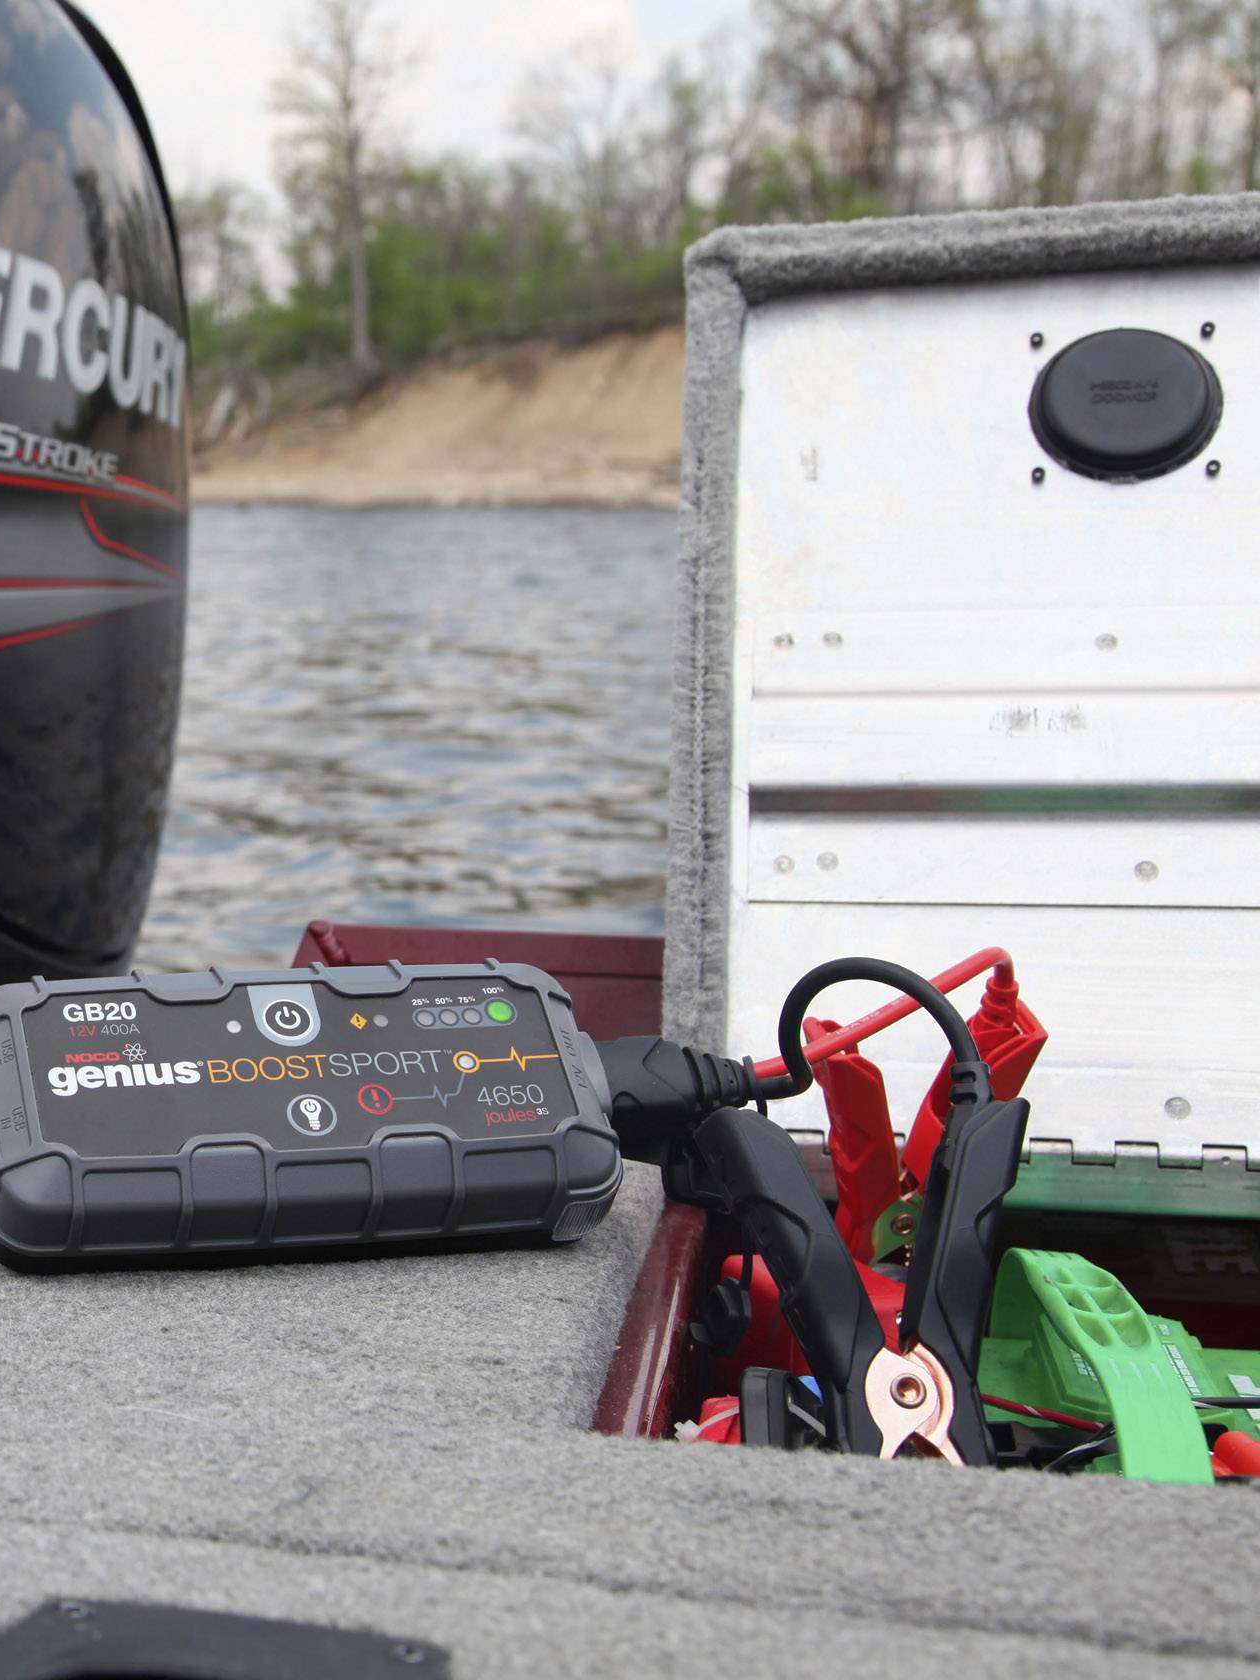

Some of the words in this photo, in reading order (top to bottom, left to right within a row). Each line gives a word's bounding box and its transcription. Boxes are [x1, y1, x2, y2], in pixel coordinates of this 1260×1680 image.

[411, 998, 430, 1006] 25%
[434, 997, 453, 1005] 50%
[457, 995, 476, 1004] 75%
[482, 986, 505, 995] 100%
[62, 1001, 137, 1022] GB20
[67, 1025, 97, 1037] 12V
[101, 1023, 141, 1036] 400A
[2, 1039, 15, 1063] USB
[64, 1052, 120, 1063] NOCO
[47, 1061, 201, 1097] genius
[477, 1083, 544, 1106] 4650
[12, 1106, 27, 1132] USB
